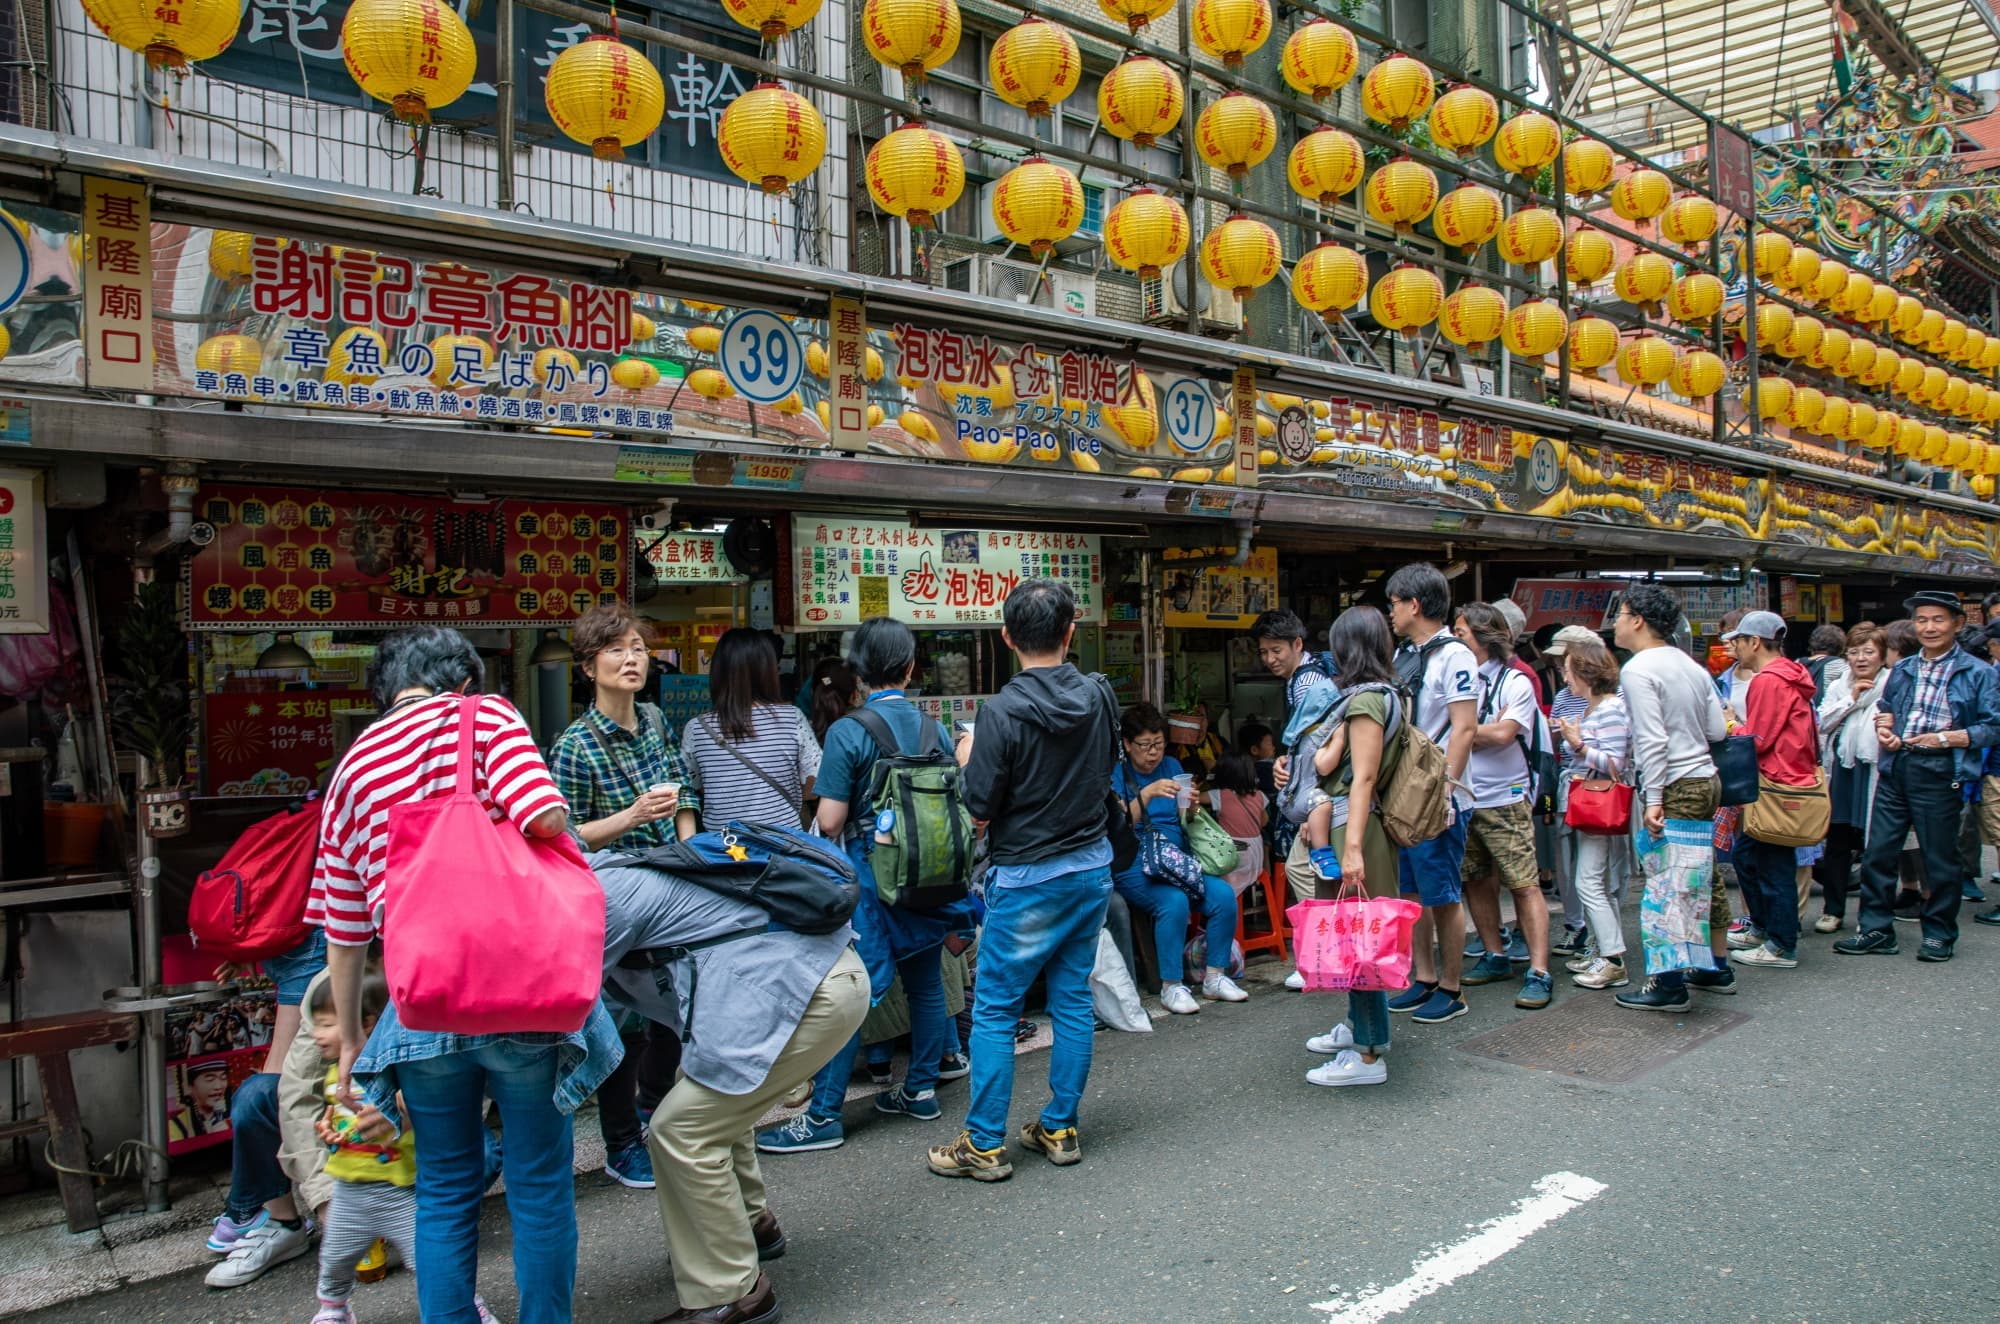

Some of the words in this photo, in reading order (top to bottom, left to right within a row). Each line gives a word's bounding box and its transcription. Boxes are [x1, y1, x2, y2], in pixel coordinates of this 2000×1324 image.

[96, 193, 142, 364] 基隆廟口
[252, 237, 633, 355] 謝記章魚腳
[283, 327, 609, 397] 章魚の足ばかり
[739, 324, 789, 386] 39
[837, 308, 862, 432] 基隆廟口
[893, 323, 1001, 389] 泡泡冰
[1059, 351, 1147, 408] 創始人
[956, 393, 993, 418] 沈家
[956, 418, 1057, 450] Pao-Pao
[1070, 431, 1102, 455] Ice
[1175, 391, 1204, 438] 37
[1236, 373, 1255, 472] 基隆廟口
[752, 465, 791, 480] 1950
[309, 505, 332, 611] 魷魚串
[388, 563, 475, 597] 謝記
[520, 516, 538, 612] 章魚串
[547, 517, 568, 612] 魷魚絲
[573, 519, 591, 611] 透抽干
[838, 548, 850, 605] 情人果
[887, 549, 898, 576] 花生
[945, 567, 1019, 606] 泡泡冰
[1456, 670, 1471, 692] 2
